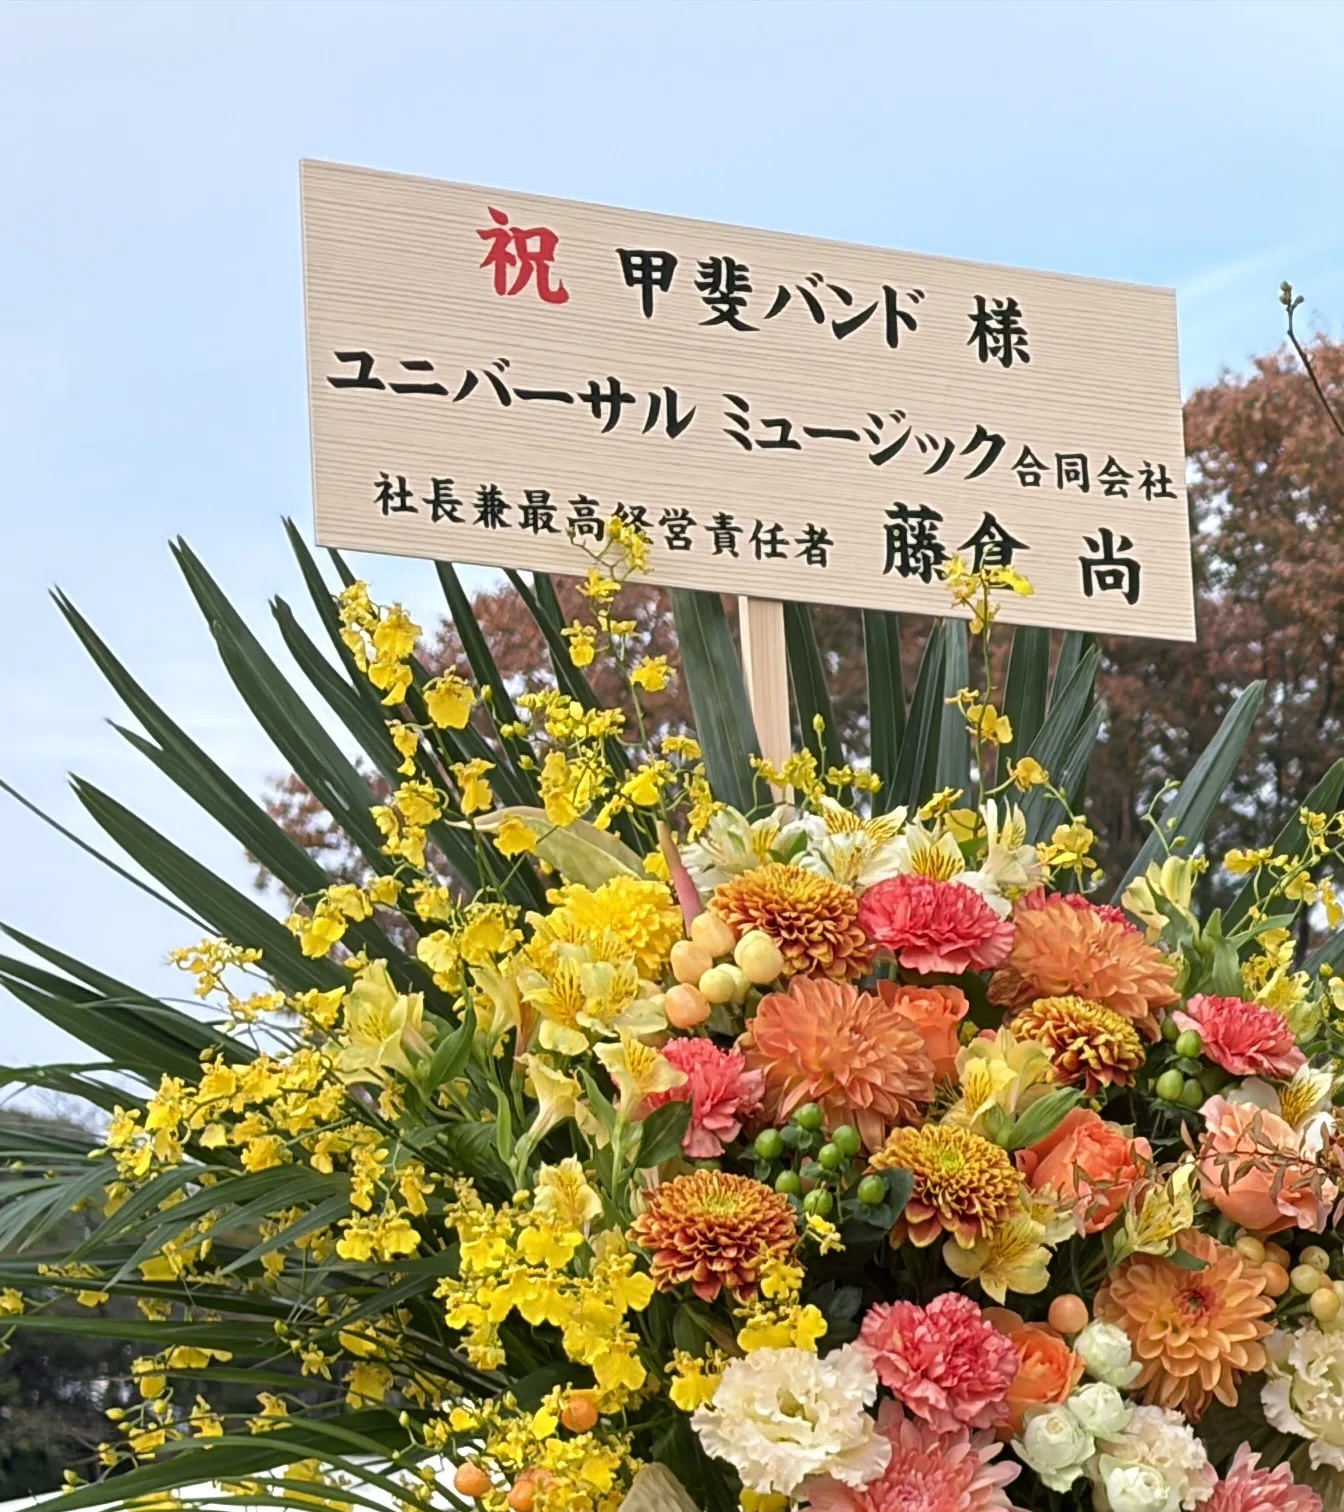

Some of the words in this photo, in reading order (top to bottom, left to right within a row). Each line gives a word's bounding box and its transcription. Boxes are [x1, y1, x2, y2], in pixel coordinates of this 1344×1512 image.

[479, 207, 570, 305] 祝
[615, 248, 925, 349] 甲斐バンド
[966, 295, 1031, 369] 様
[327, 350, 697, 439] ユニバーサル
[1078, 527, 1141, 605] 尚
